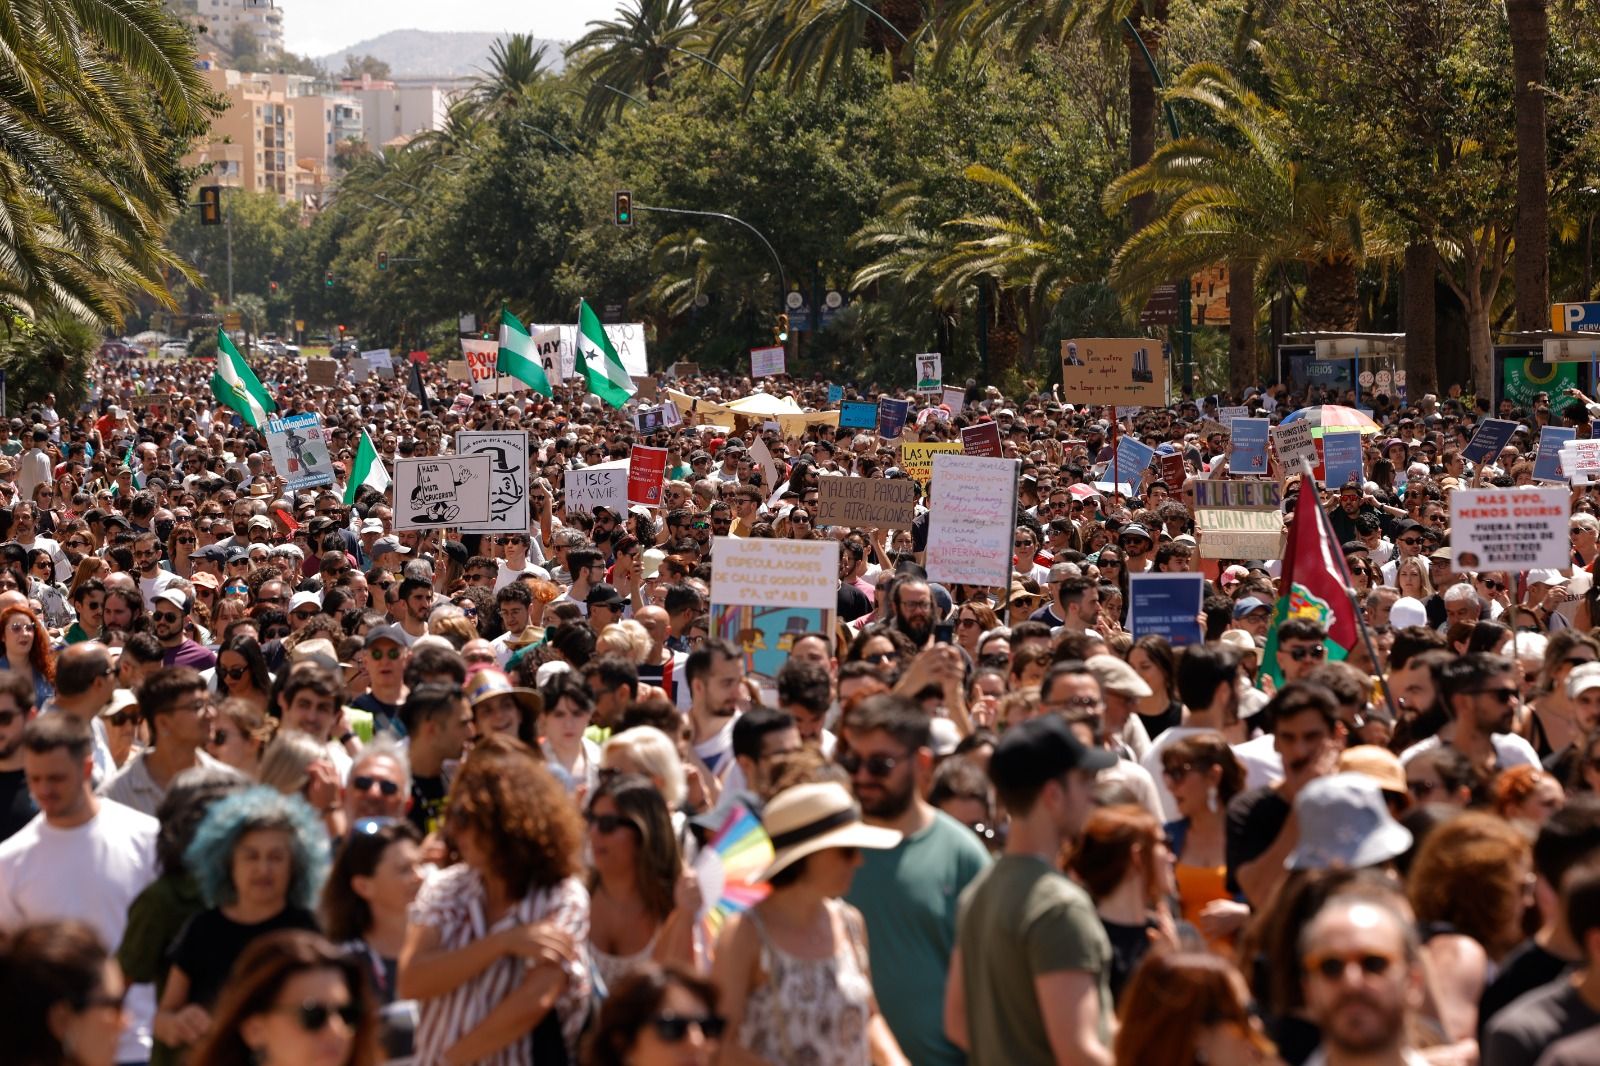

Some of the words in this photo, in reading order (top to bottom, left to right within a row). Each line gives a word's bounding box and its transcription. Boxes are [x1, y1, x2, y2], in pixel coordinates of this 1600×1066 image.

[1565, 305, 1585, 331] P
[1361, 374, 1373, 383] 32
[1377, 372, 1390, 382] 33
[904, 447, 922, 461] LAS
[421, 464, 440, 473] HASTA
[424, 484, 439, 492] VISTA
[874, 482, 914, 503] PARQUE
[820, 501, 836, 518] DE
[843, 501, 912, 524] ATRACCIONES
[1458, 507, 1508, 518] MENOS
[1513, 505, 1562, 516] GUIRIS
[1475, 522, 1512, 531] FUERA
[1541, 532, 1554, 540] DE
[726, 556, 822, 571] ESPECULADORES
[731, 572, 768, 585] CALLE
